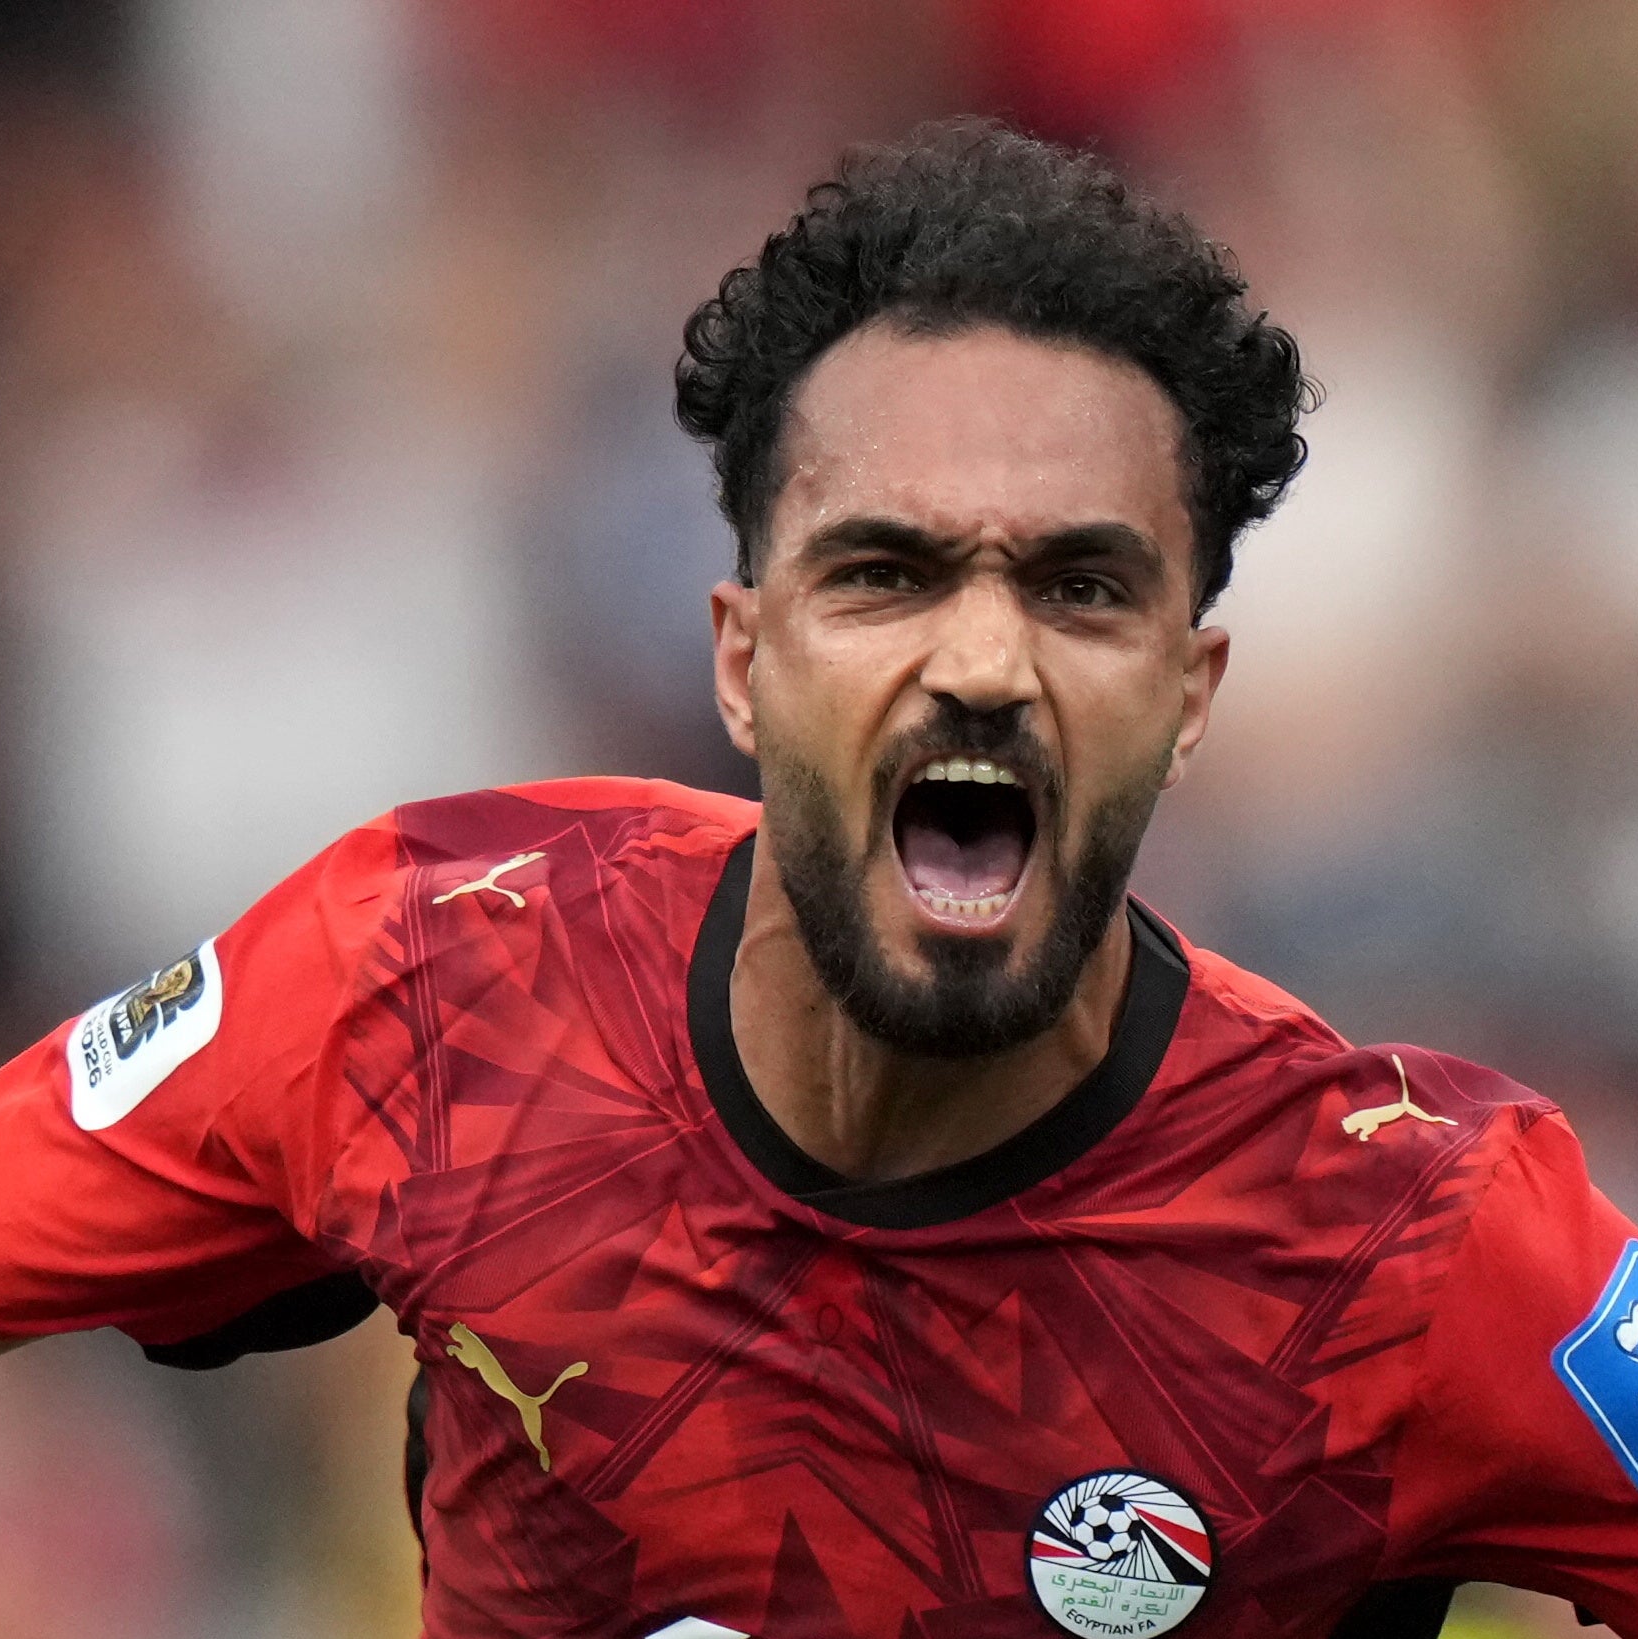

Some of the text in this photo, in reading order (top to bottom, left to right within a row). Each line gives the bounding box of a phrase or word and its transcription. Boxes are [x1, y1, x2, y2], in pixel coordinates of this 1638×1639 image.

[103, 1050, 113, 1076] CUP
[1065, 1608, 1157, 1635] EGYPTIAN FA
